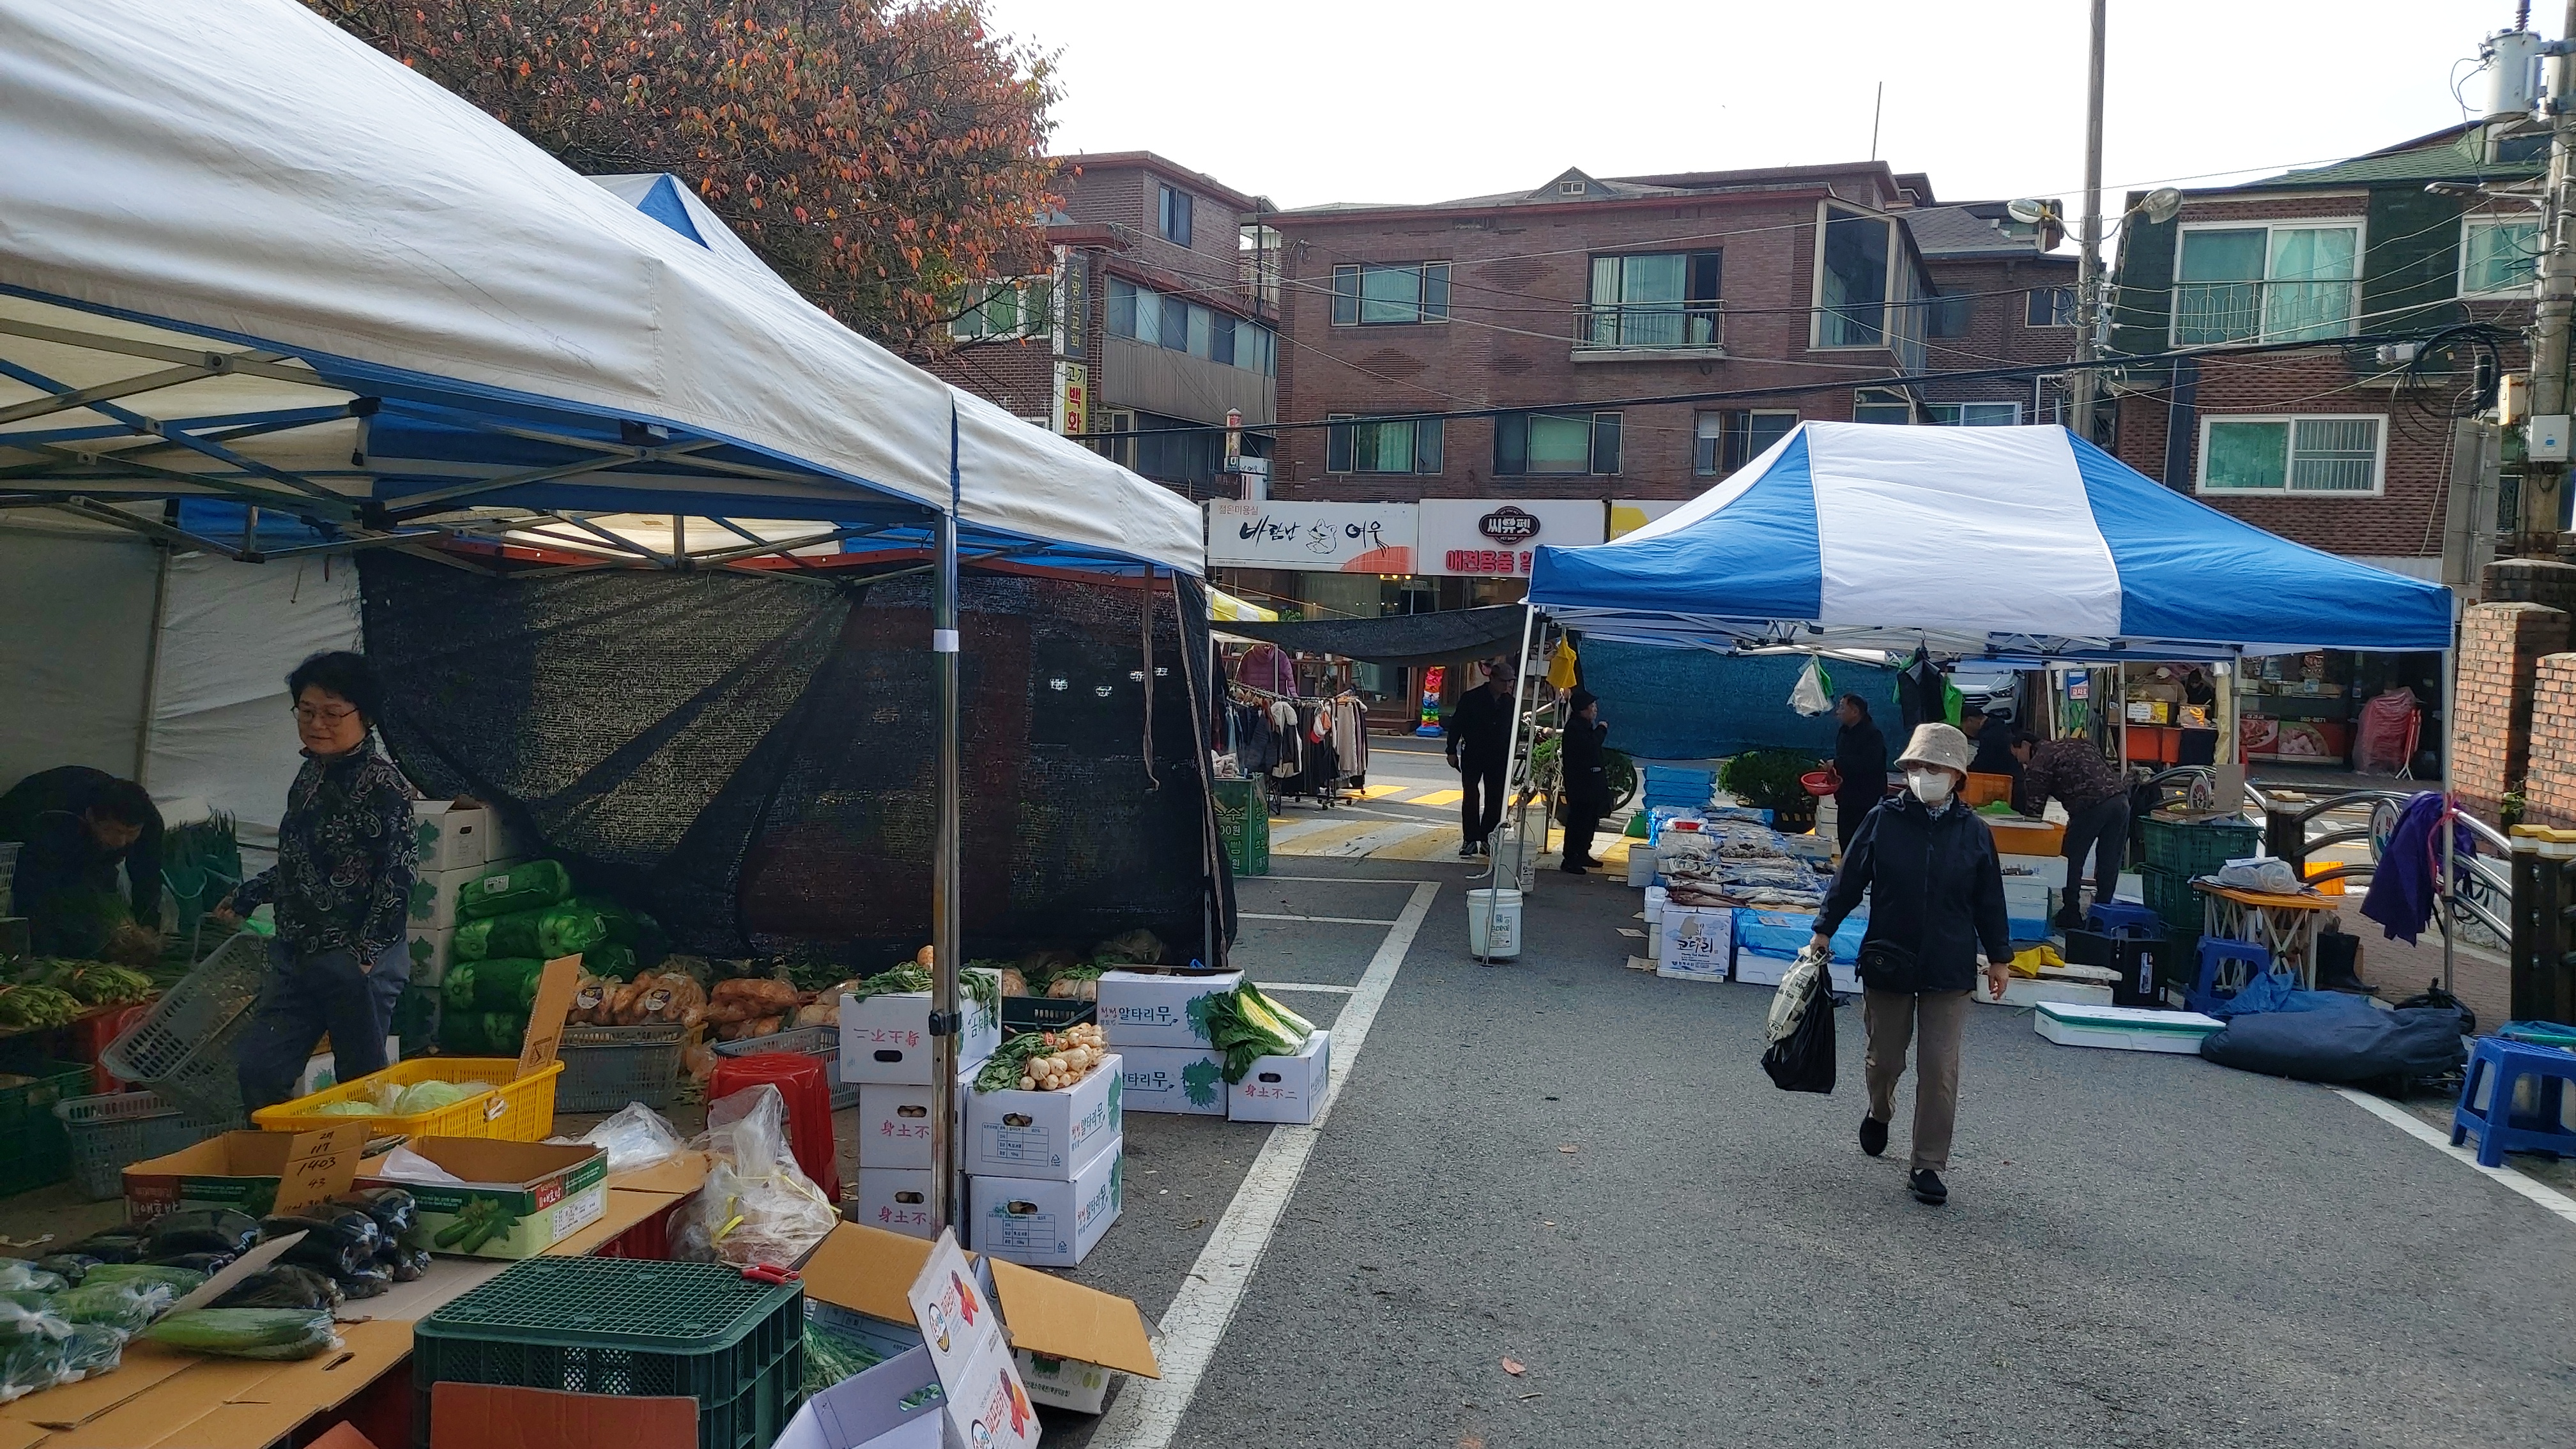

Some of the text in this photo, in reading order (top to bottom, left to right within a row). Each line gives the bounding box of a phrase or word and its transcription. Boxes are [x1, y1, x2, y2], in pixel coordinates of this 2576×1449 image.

[1066, 366, 1085, 385] 고기
[1219, 505, 1259, 516] 젊은미용실
[1487, 516, 1531, 534] 씨유펫
[1239, 514, 1390, 558] 바람난 여우
[1446, 549, 1515, 572] 애견용품
[1676, 937, 1713, 953] 코다리
[1118, 1006, 1172, 1022] 알타리무
[971, 1011, 991, 1038] 타리무
[854, 1028, 920, 1047] 身土不二
[1123, 1071, 1168, 1087] 타리무
[1245, 1084, 1298, 1100] 身土不二
[881, 1119, 930, 1139] 身土不
[1080, 1102, 1104, 1137] 알타리무
[1086, 1183, 1107, 1220] 알타리무
[878, 1206, 931, 1225] 身土不
[985, 1385, 1009, 1435] 파프리카
